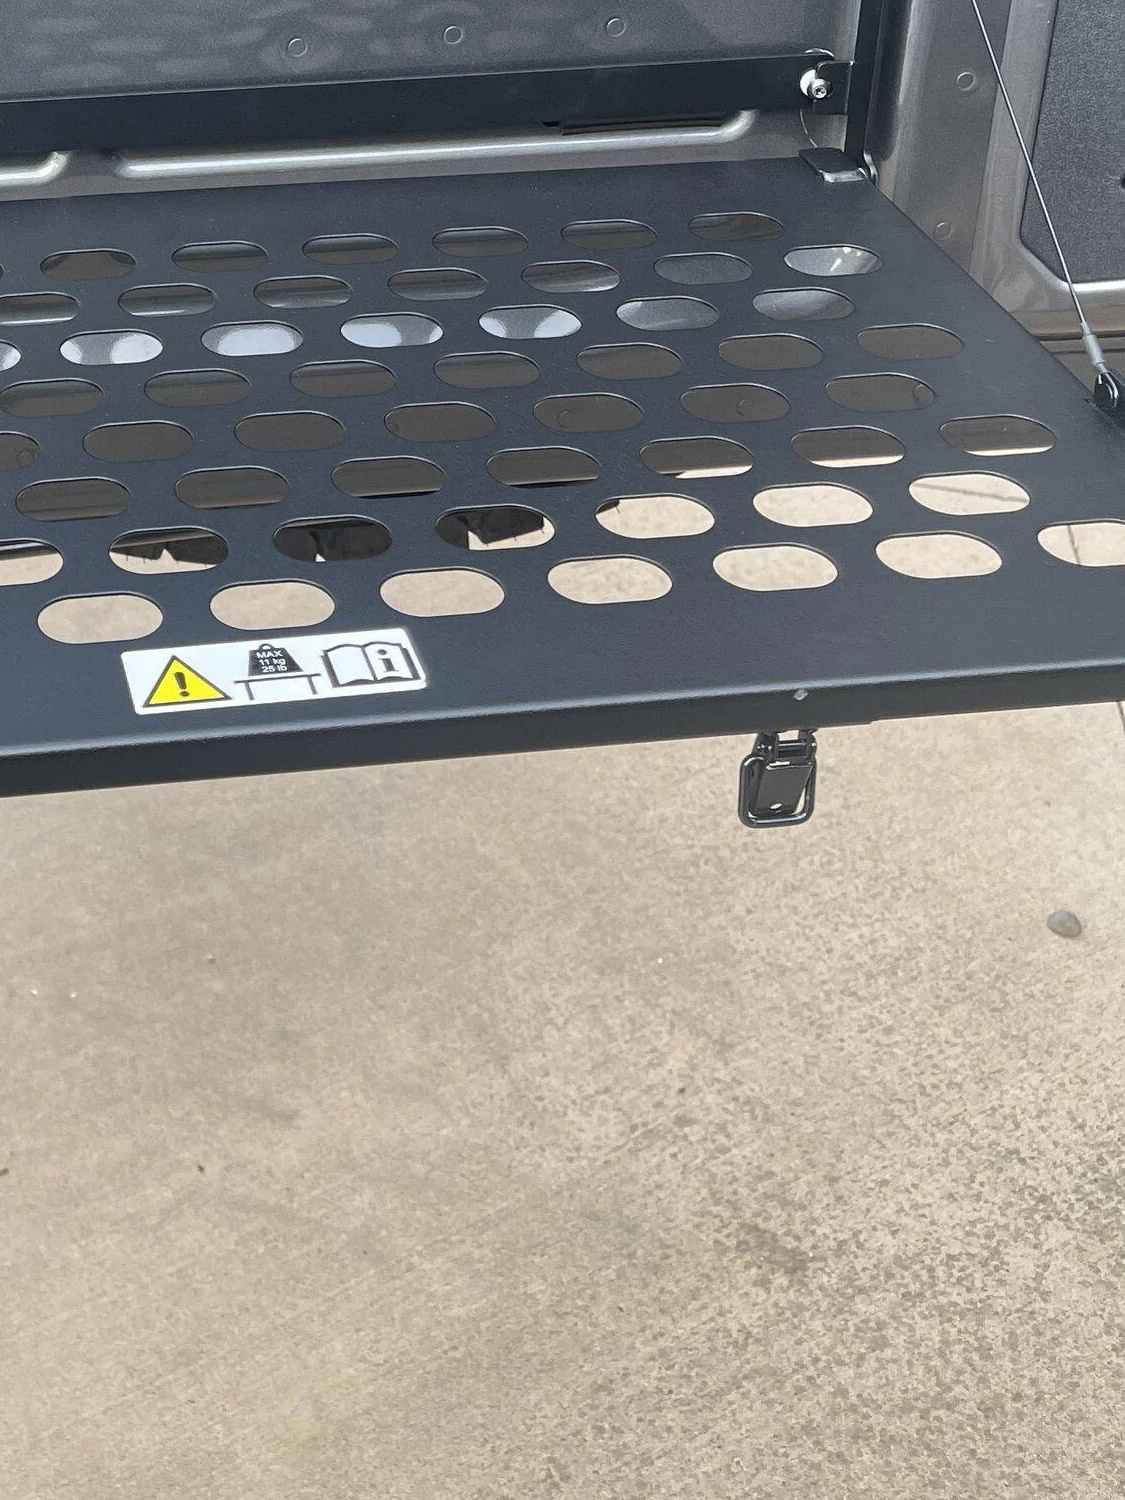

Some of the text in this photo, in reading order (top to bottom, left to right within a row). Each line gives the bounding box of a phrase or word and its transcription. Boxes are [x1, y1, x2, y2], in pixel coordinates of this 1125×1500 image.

[256, 650, 283, 659] MAX
[272, 658, 286, 666] kg
[261, 664, 288, 673] 25 lb
